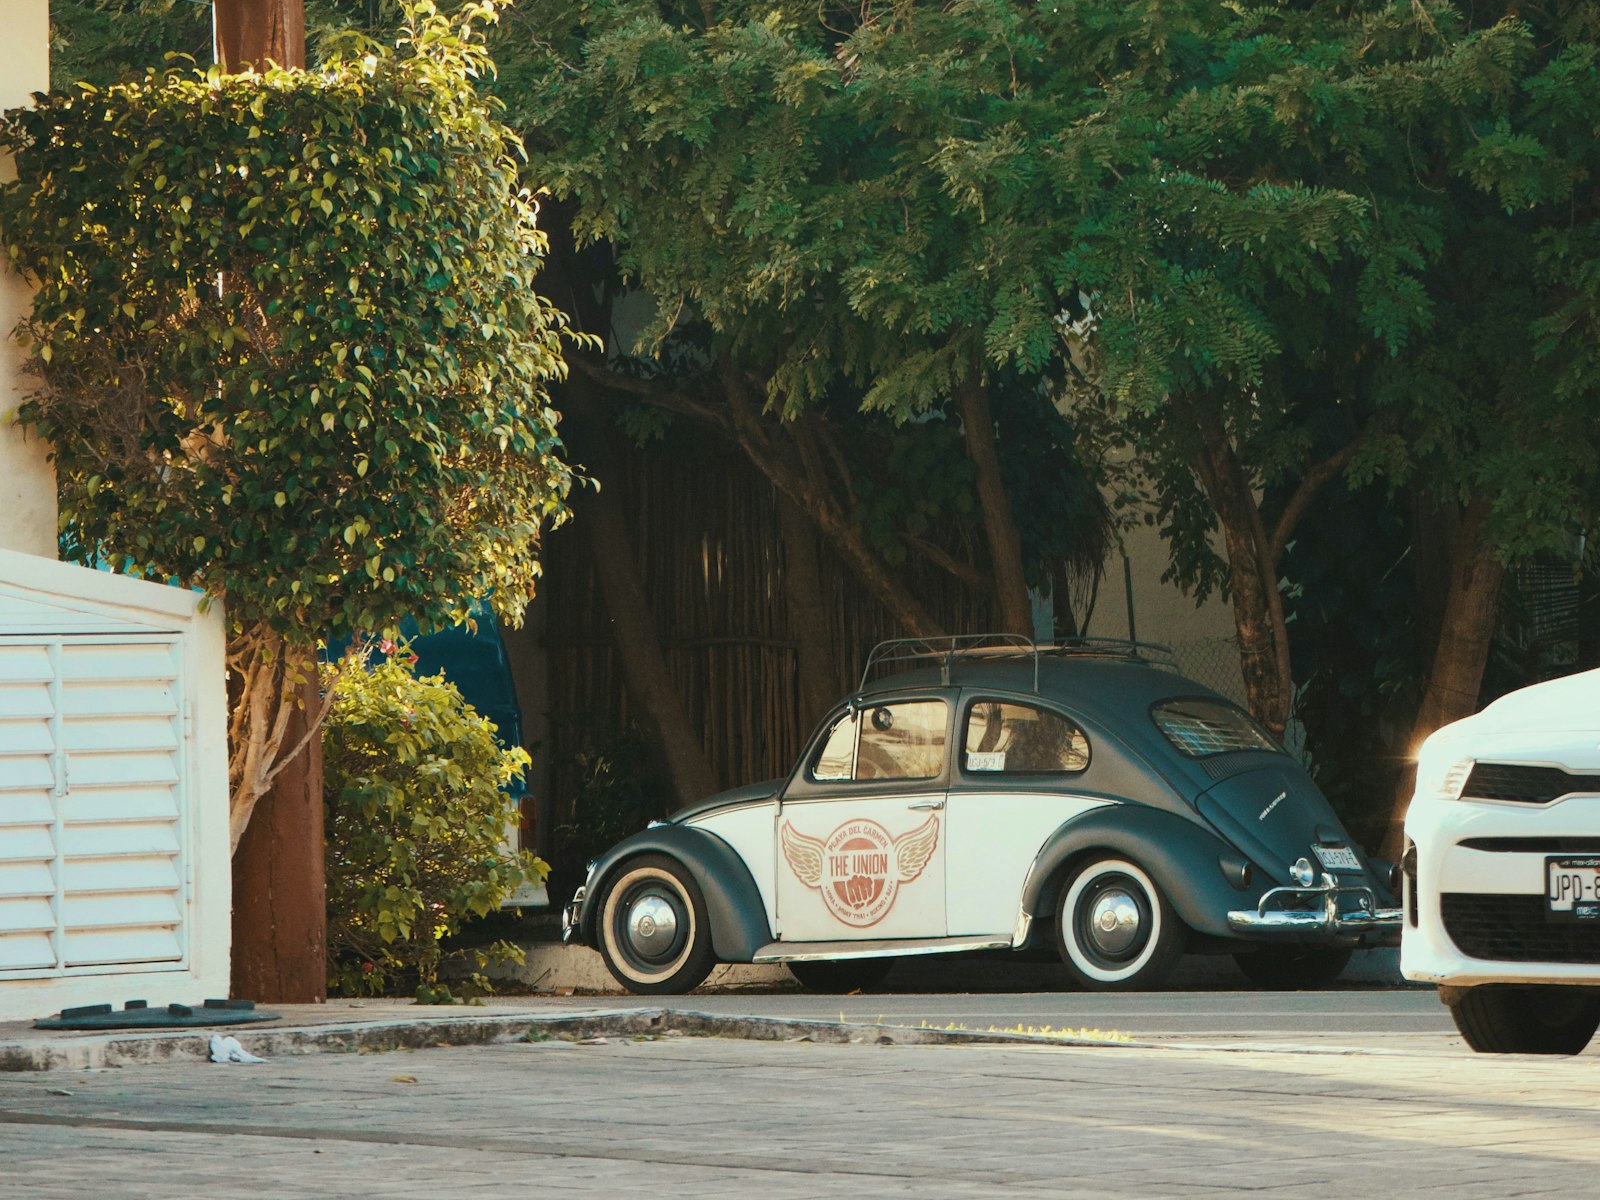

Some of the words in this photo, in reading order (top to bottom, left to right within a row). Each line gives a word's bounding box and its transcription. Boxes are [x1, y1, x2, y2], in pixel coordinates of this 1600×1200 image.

[828, 831, 847, 851] PLAYA
[849, 826, 862, 834] DEL
[864, 827, 888, 848] CARMEN
[829, 855, 849, 877] THE
[853, 854, 888, 875] UNION
[870, 901, 886, 917] BOXING
